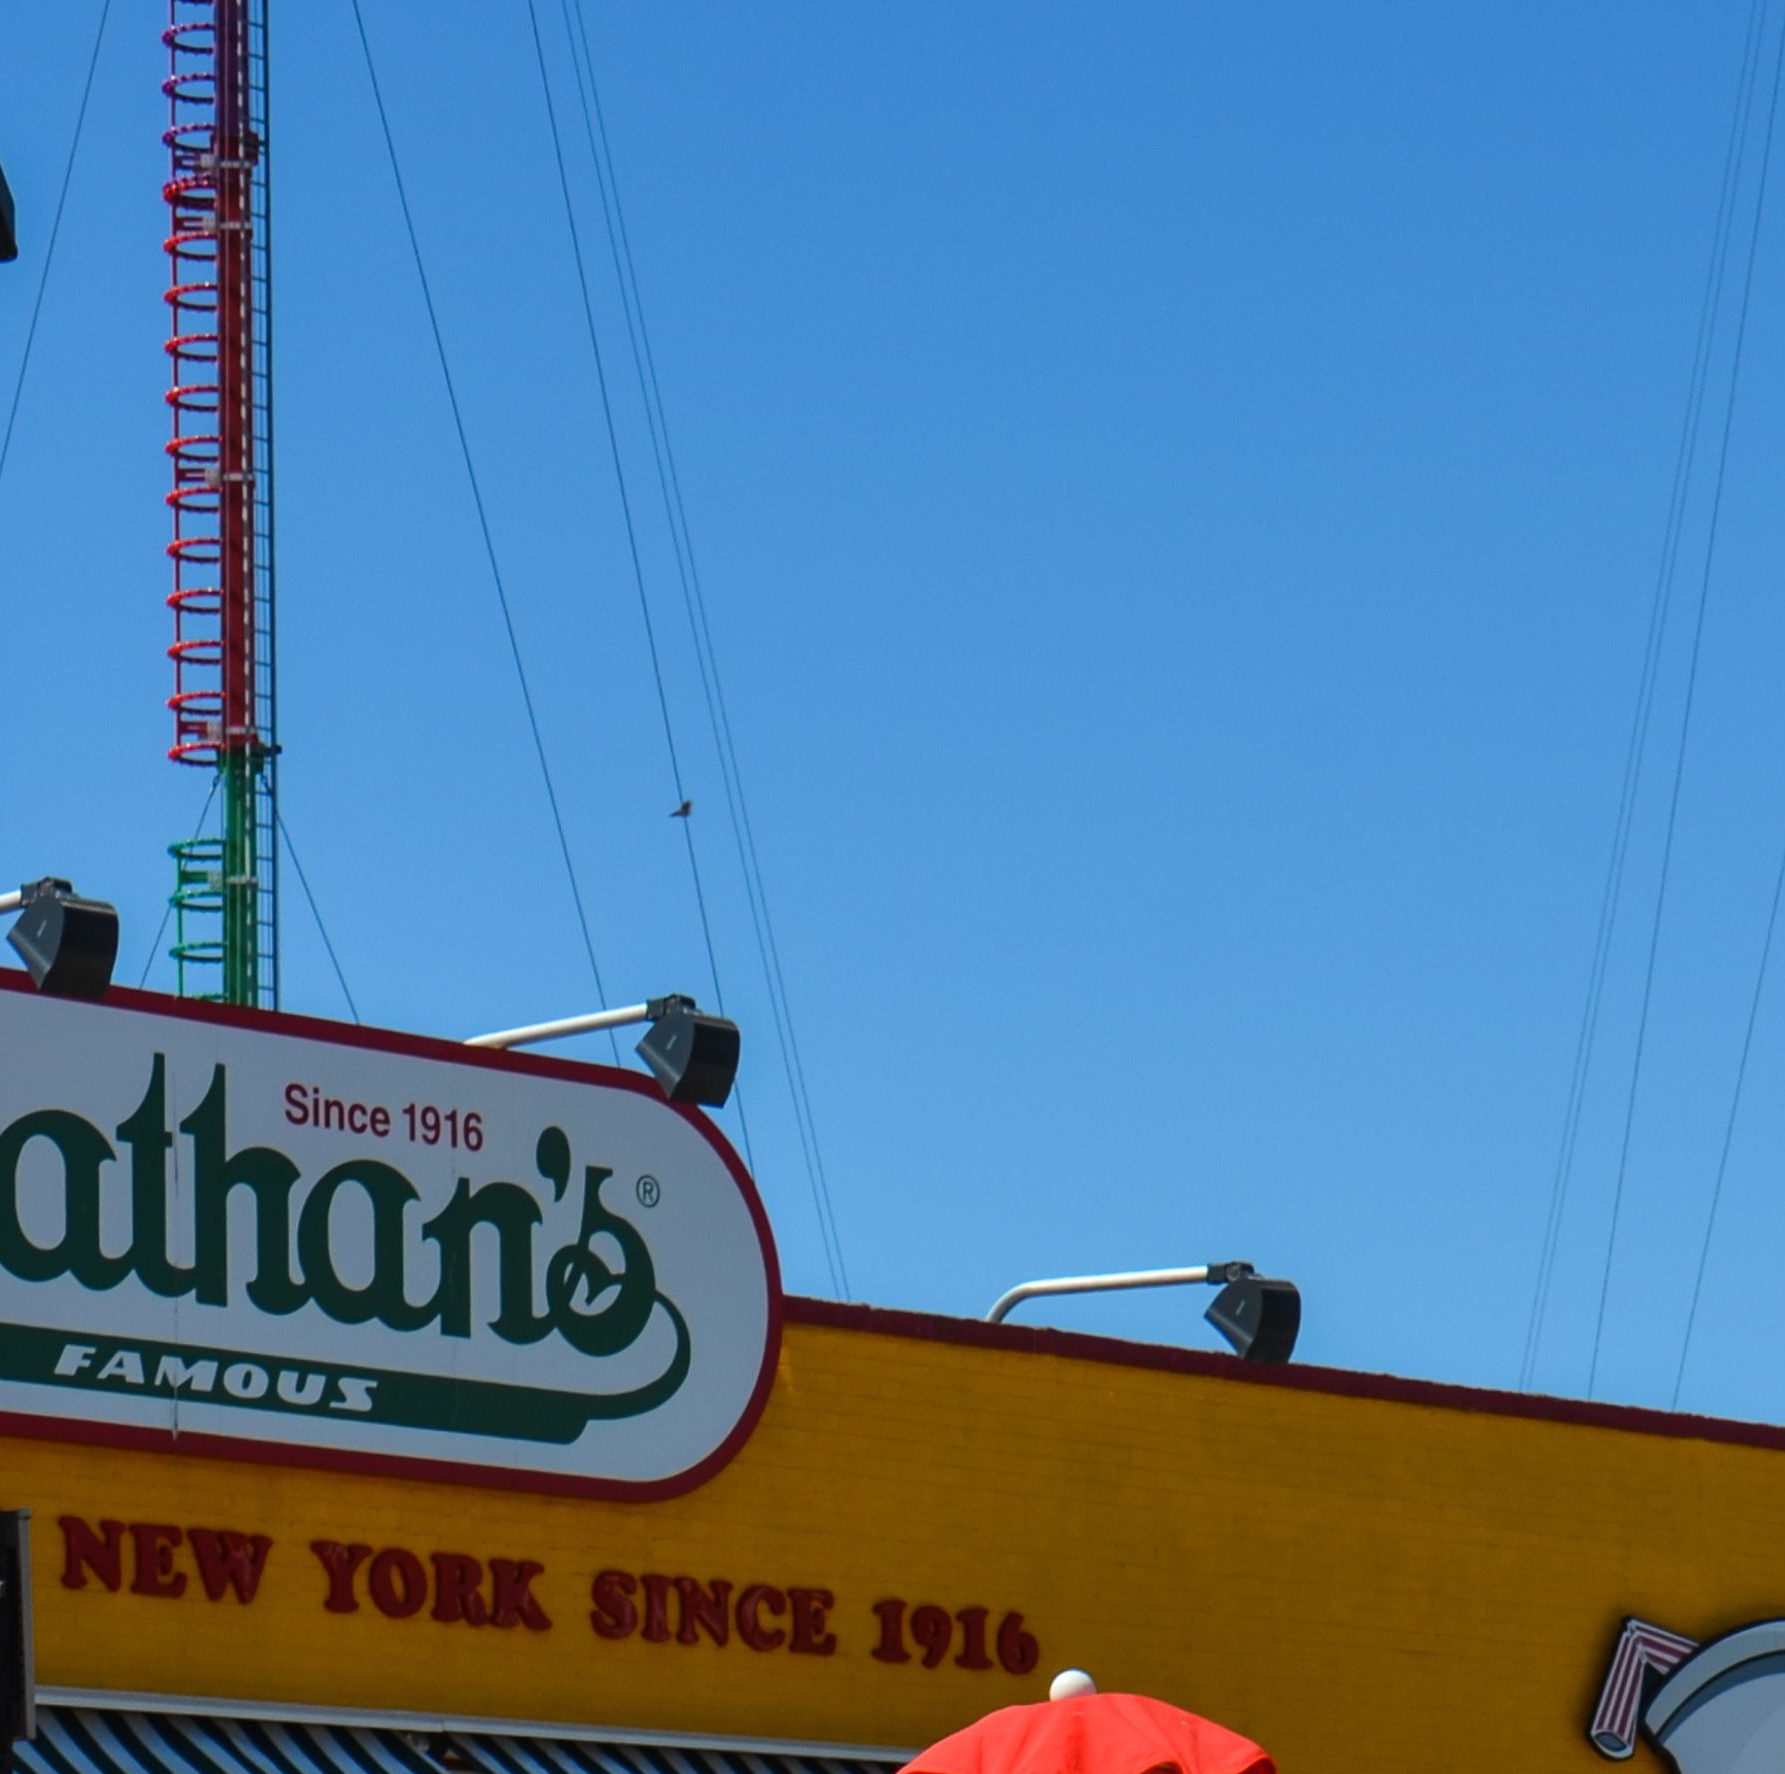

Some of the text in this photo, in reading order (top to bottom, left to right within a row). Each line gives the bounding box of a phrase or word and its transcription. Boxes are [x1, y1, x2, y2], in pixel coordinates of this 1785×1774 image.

[283, 1081, 486, 1153] Since 1916
[54, 1342, 380, 1414] FAMOUS
[57, 1514, 274, 1606] NEW
[311, 1537, 553, 1633] YORK
[589, 1568, 839, 1658] SINCE
[870, 1597, 1041, 1677] 1916
